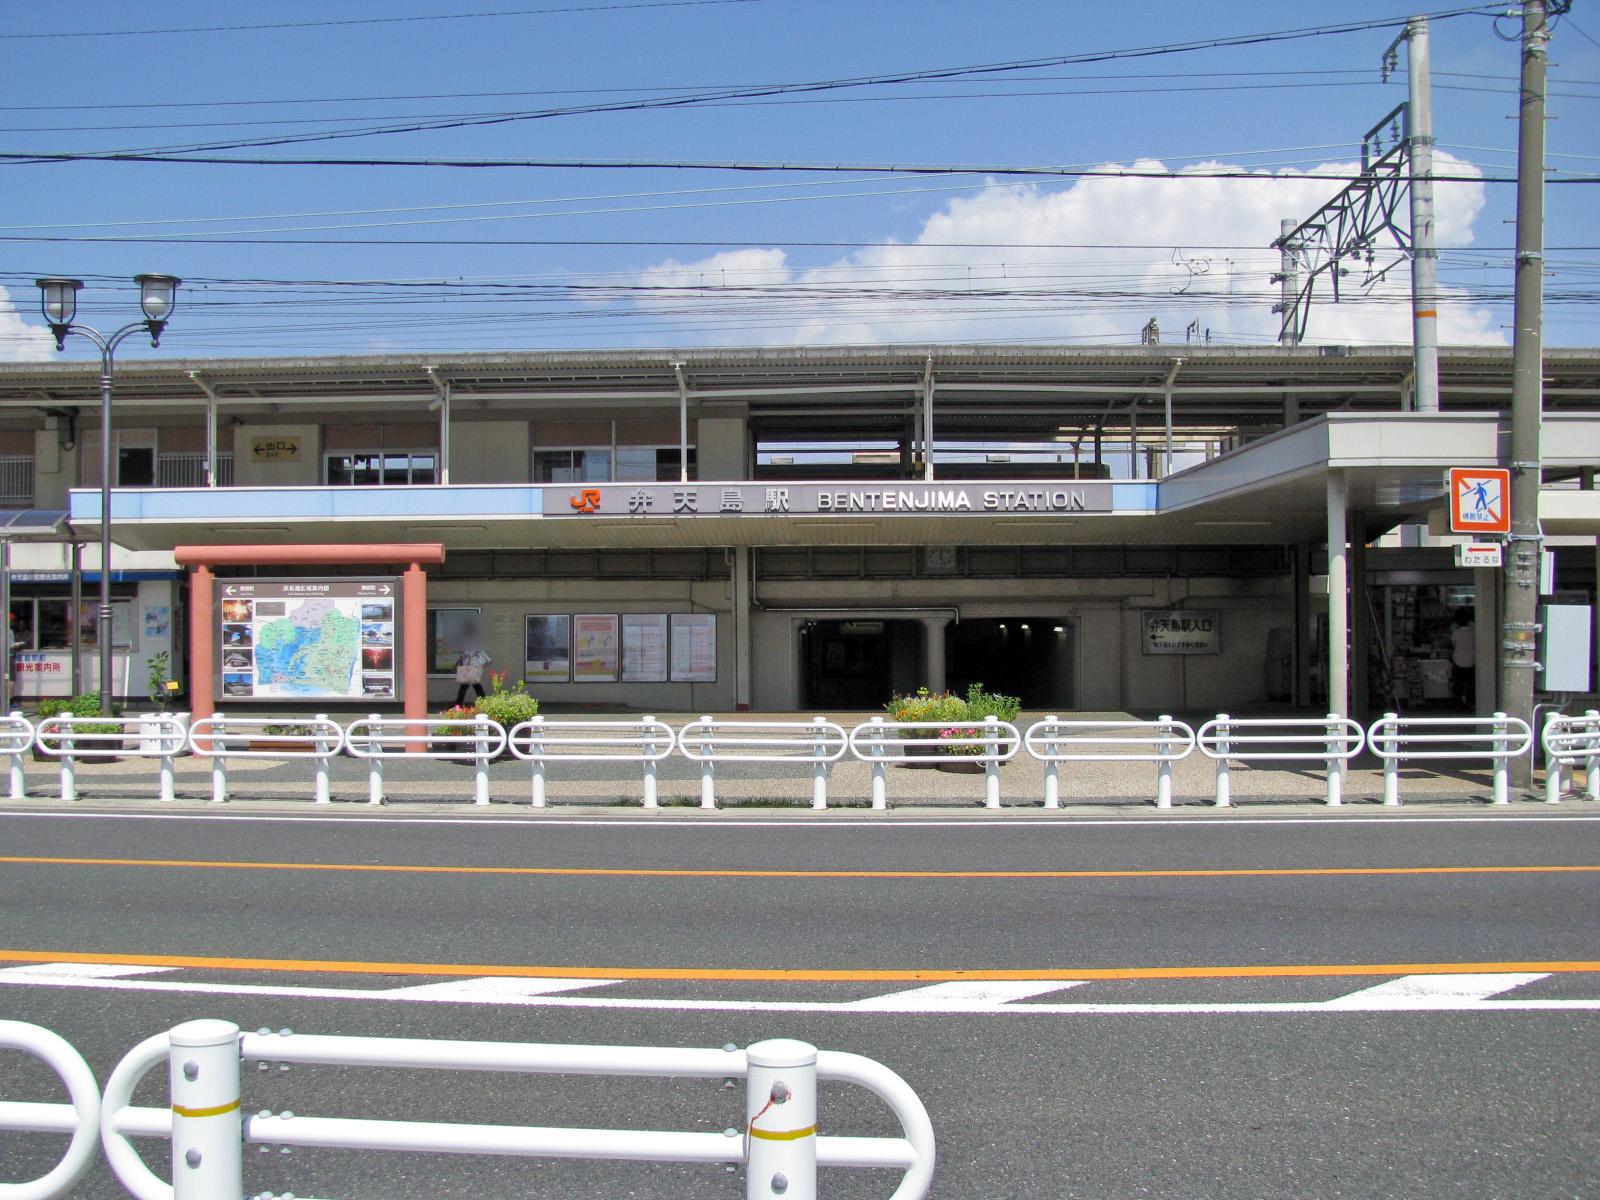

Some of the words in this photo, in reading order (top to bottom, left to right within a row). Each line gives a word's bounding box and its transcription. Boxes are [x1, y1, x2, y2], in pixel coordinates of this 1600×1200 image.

[266, 440, 286, 451] 出口
[570, 488, 600, 512] JR
[628, 488, 790, 512] 弁天島駅
[818, 490, 971, 510] BENTENJIMA
[983, 491, 1086, 510] STATION
[1462, 512, 1489, 521] 横断禁止
[1465, 555, 1499, 564] わたるな
[1150, 618, 1212, 633] 弁天島駅入口
[16, 662, 61, 672] 観光案内所
